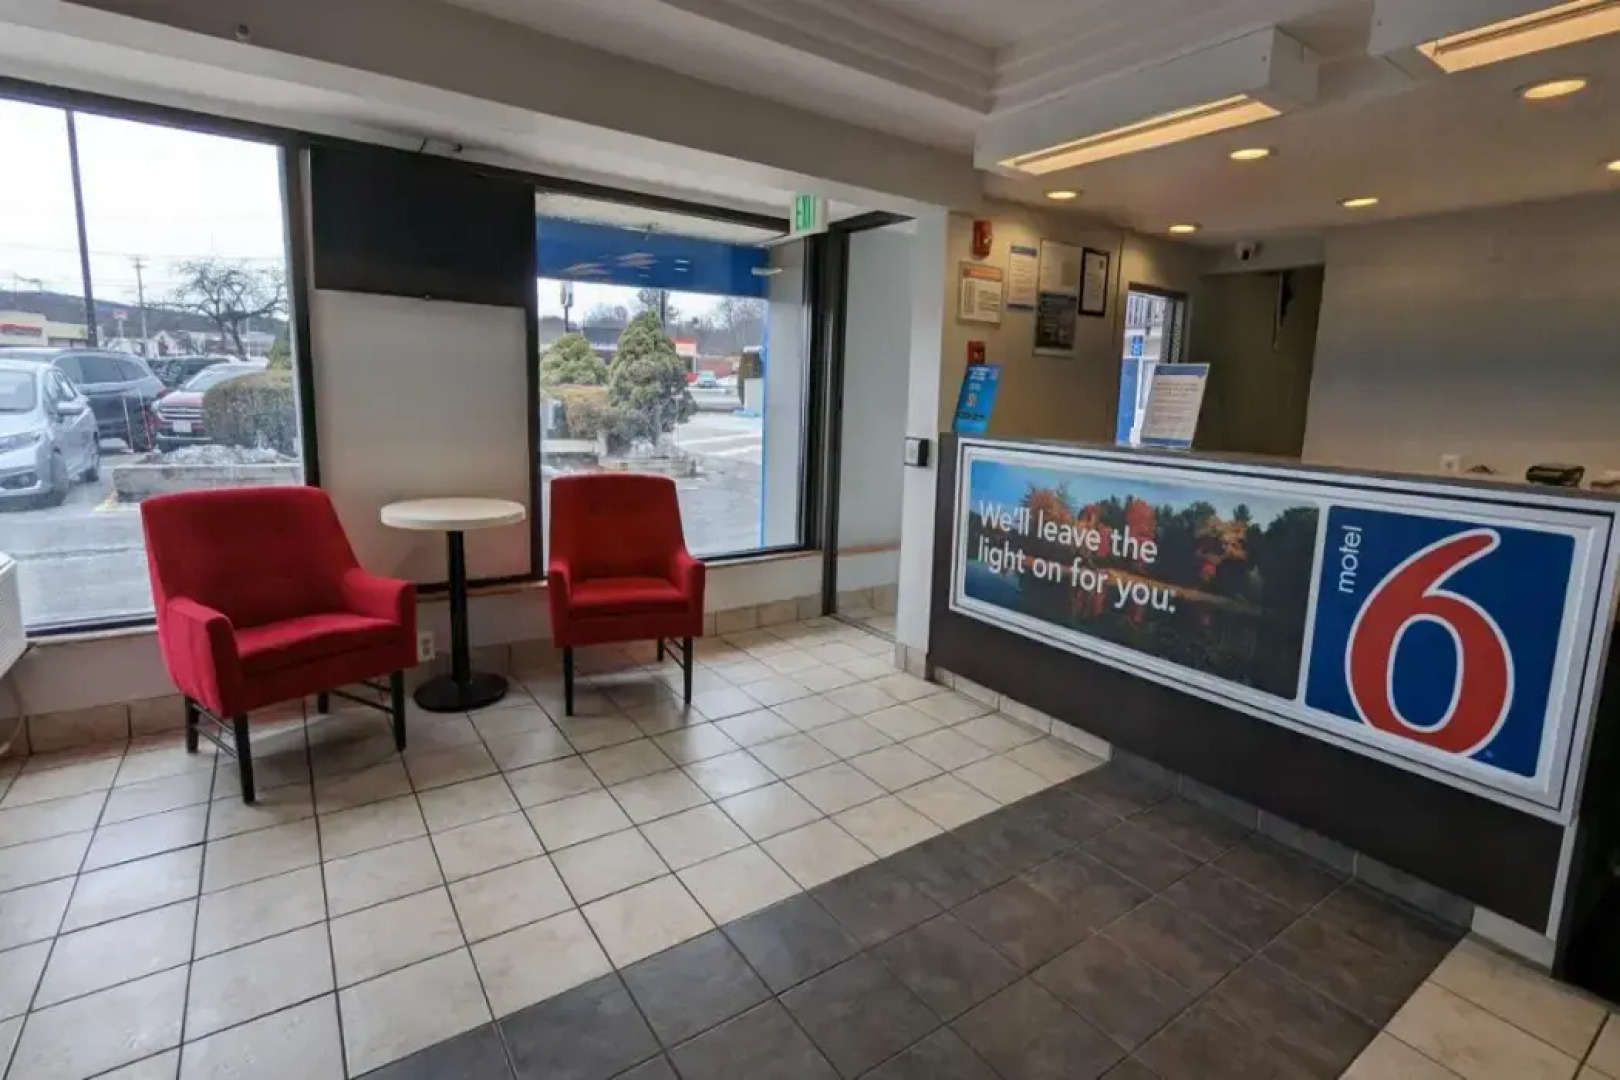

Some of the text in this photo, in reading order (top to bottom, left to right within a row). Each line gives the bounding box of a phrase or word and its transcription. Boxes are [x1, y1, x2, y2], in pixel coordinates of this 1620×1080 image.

[979, 500, 1158, 563] We'll leave the
[977, 534, 1026, 573] light
[1032, 557, 1061, 583] on
[1071, 556, 1108, 593] for
[1339, 525, 1515, 756] motel 6
